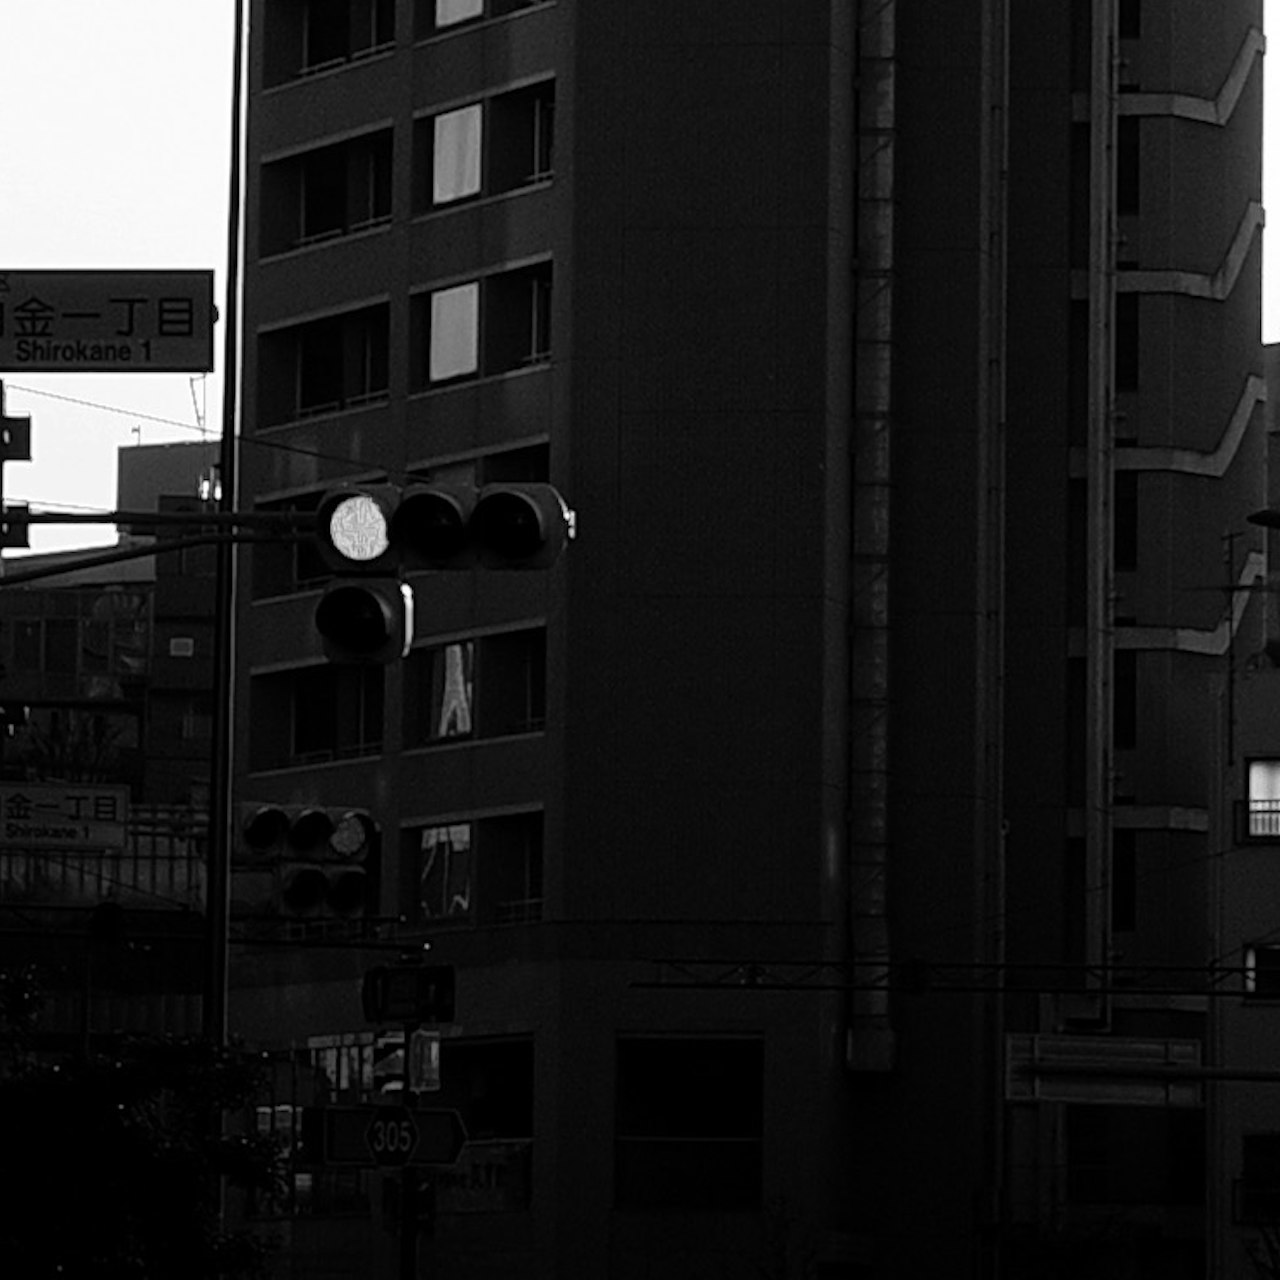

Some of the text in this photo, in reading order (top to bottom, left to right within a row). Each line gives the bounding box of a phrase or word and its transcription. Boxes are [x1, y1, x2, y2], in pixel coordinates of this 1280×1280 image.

[17, 340, 152, 362] Shirokane 1
[373, 1120, 412, 1153] 305
